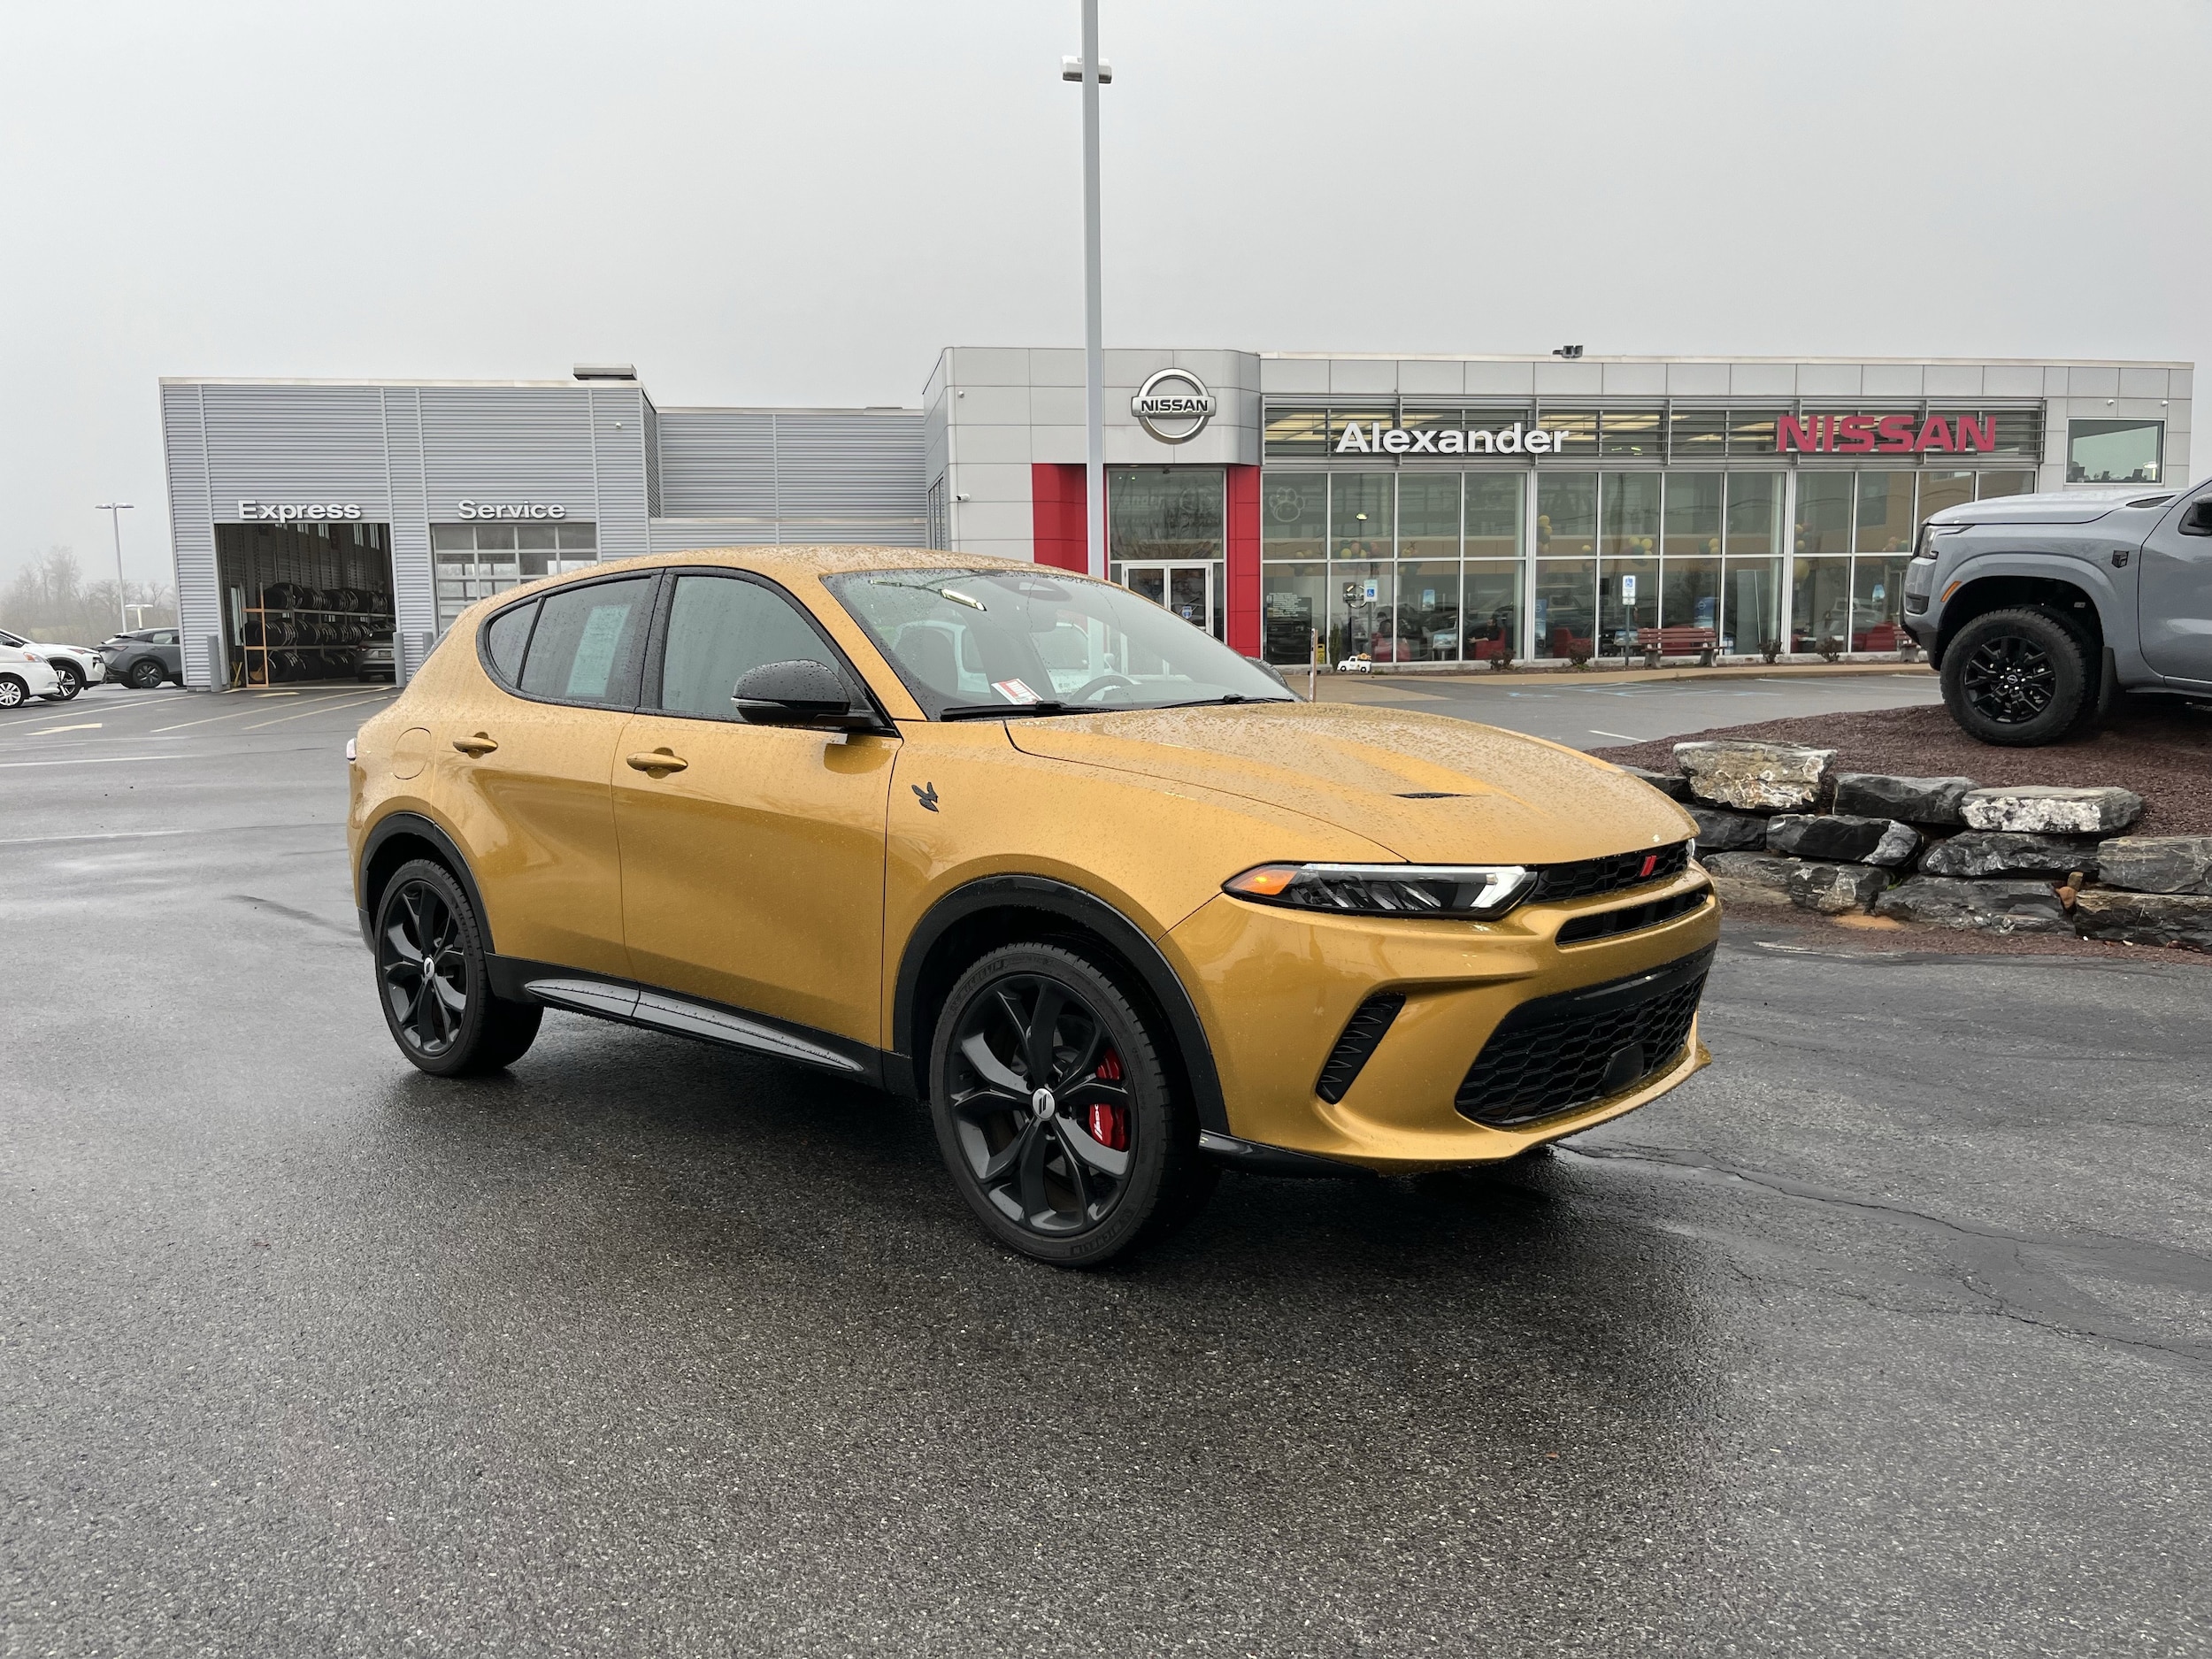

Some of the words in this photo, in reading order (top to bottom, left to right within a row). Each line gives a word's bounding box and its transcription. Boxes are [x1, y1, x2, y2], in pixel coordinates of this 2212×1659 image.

[1141, 400, 1209, 413] NISSAN
[1334, 422, 1571, 454] Alexander
[1776, 415, 1997, 453] NISSAN
[237, 499, 362, 523] Express
[457, 499, 566, 519] Service
